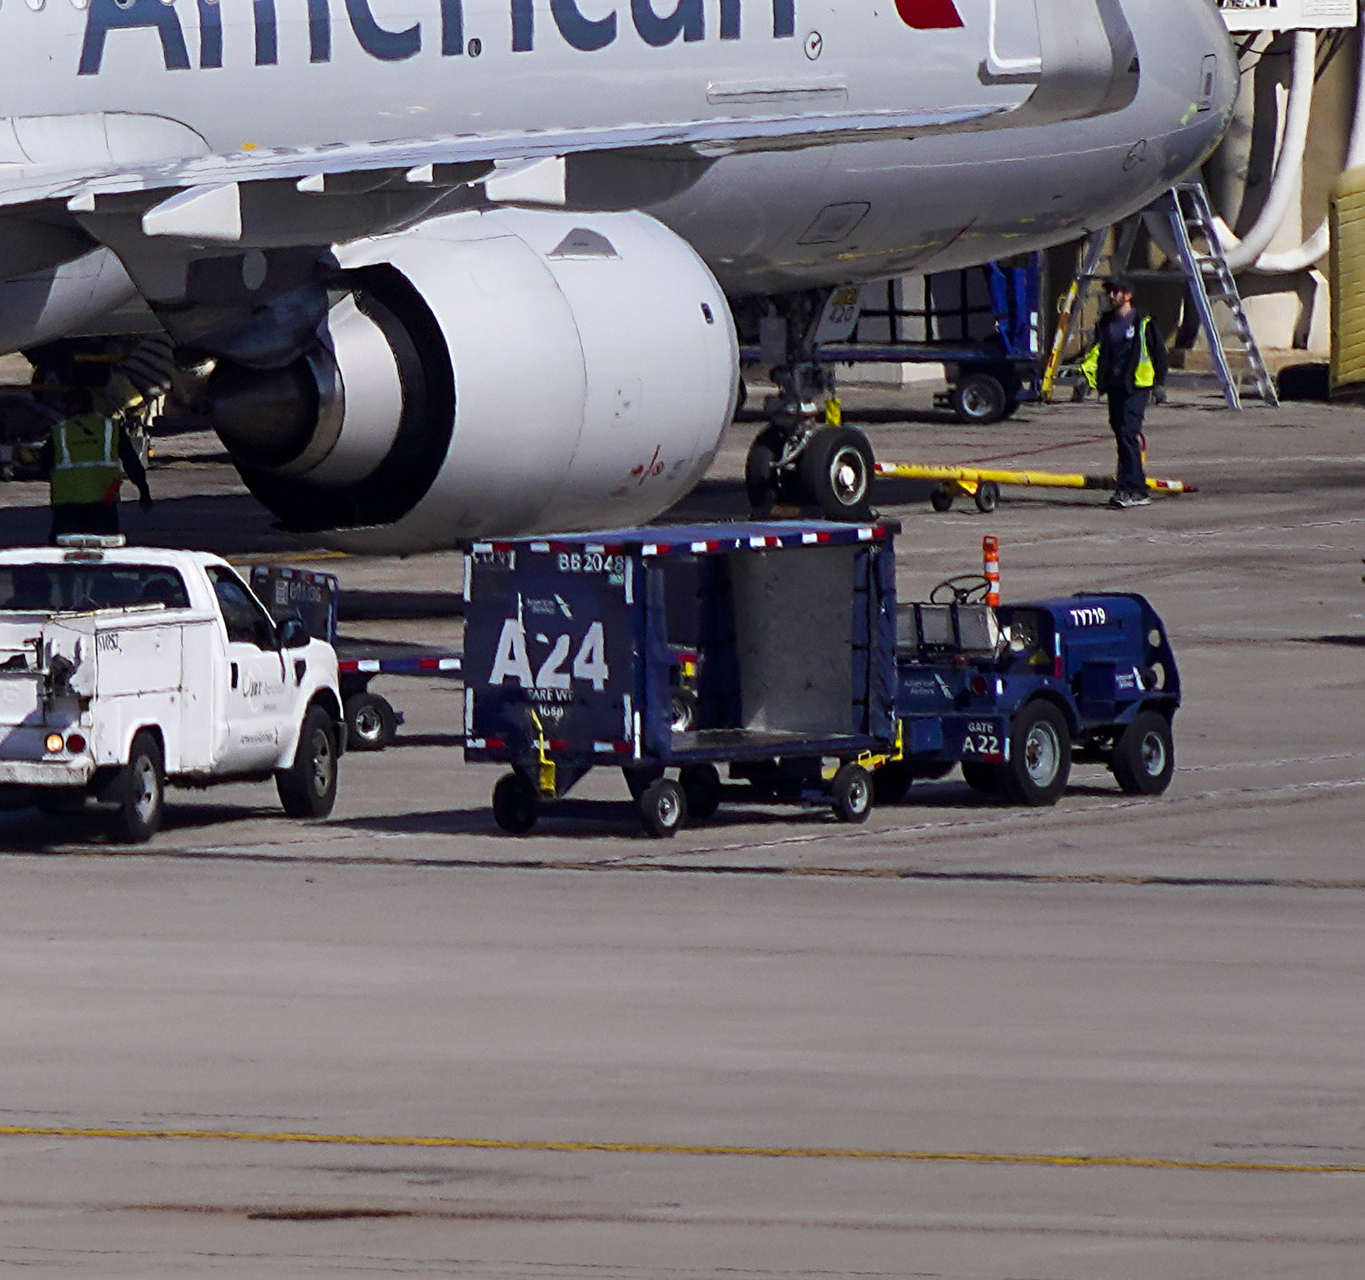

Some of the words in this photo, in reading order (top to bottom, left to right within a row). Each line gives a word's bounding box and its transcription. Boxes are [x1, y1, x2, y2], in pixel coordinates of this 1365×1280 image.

[1070, 606, 1106, 627] TY719
[488, 618, 610, 692] A24
[968, 722, 994, 733] GATE
